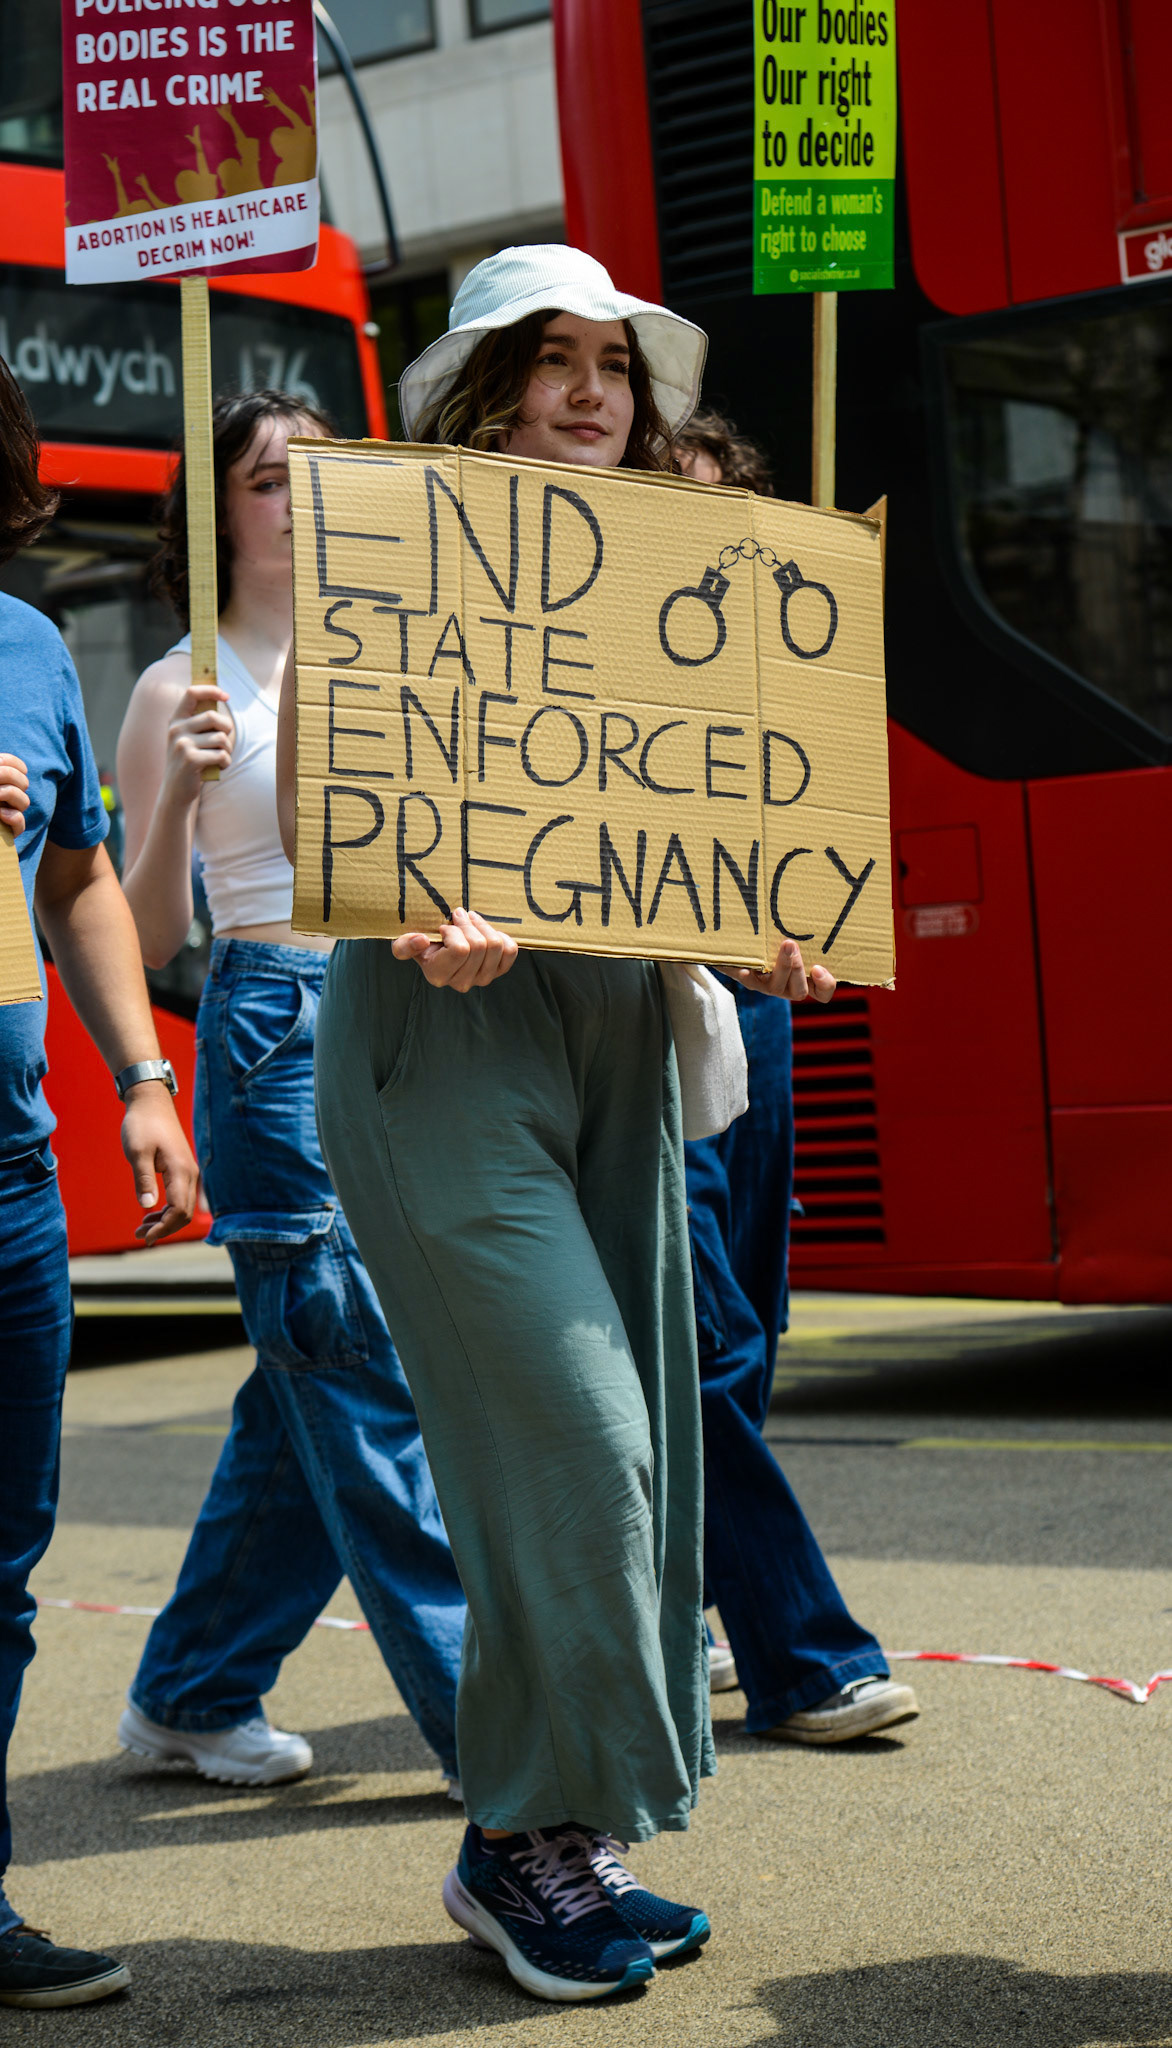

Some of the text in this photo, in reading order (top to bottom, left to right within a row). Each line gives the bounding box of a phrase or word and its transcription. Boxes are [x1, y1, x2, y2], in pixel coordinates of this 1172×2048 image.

[75, 20, 295, 64] BODIES IS THE
[762, 0, 888, 46] Our bodies
[76, 70, 265, 113] REAL CRIME
[762, 54, 872, 117] Our right
[762, 118, 874, 167] to decide
[76, 192, 308, 251] ABORTION IS HEALTHCARE
[761, 186, 883, 216] Defend a woman's
[137, 229, 255, 267] DECRIM NOW!
[761, 223, 867, 260] right to choose
[306, 454, 604, 616] END
[323, 600, 596, 700] STATE
[328, 679, 812, 806] ENFORCED
[322, 784, 876, 955] PREGNANCY
